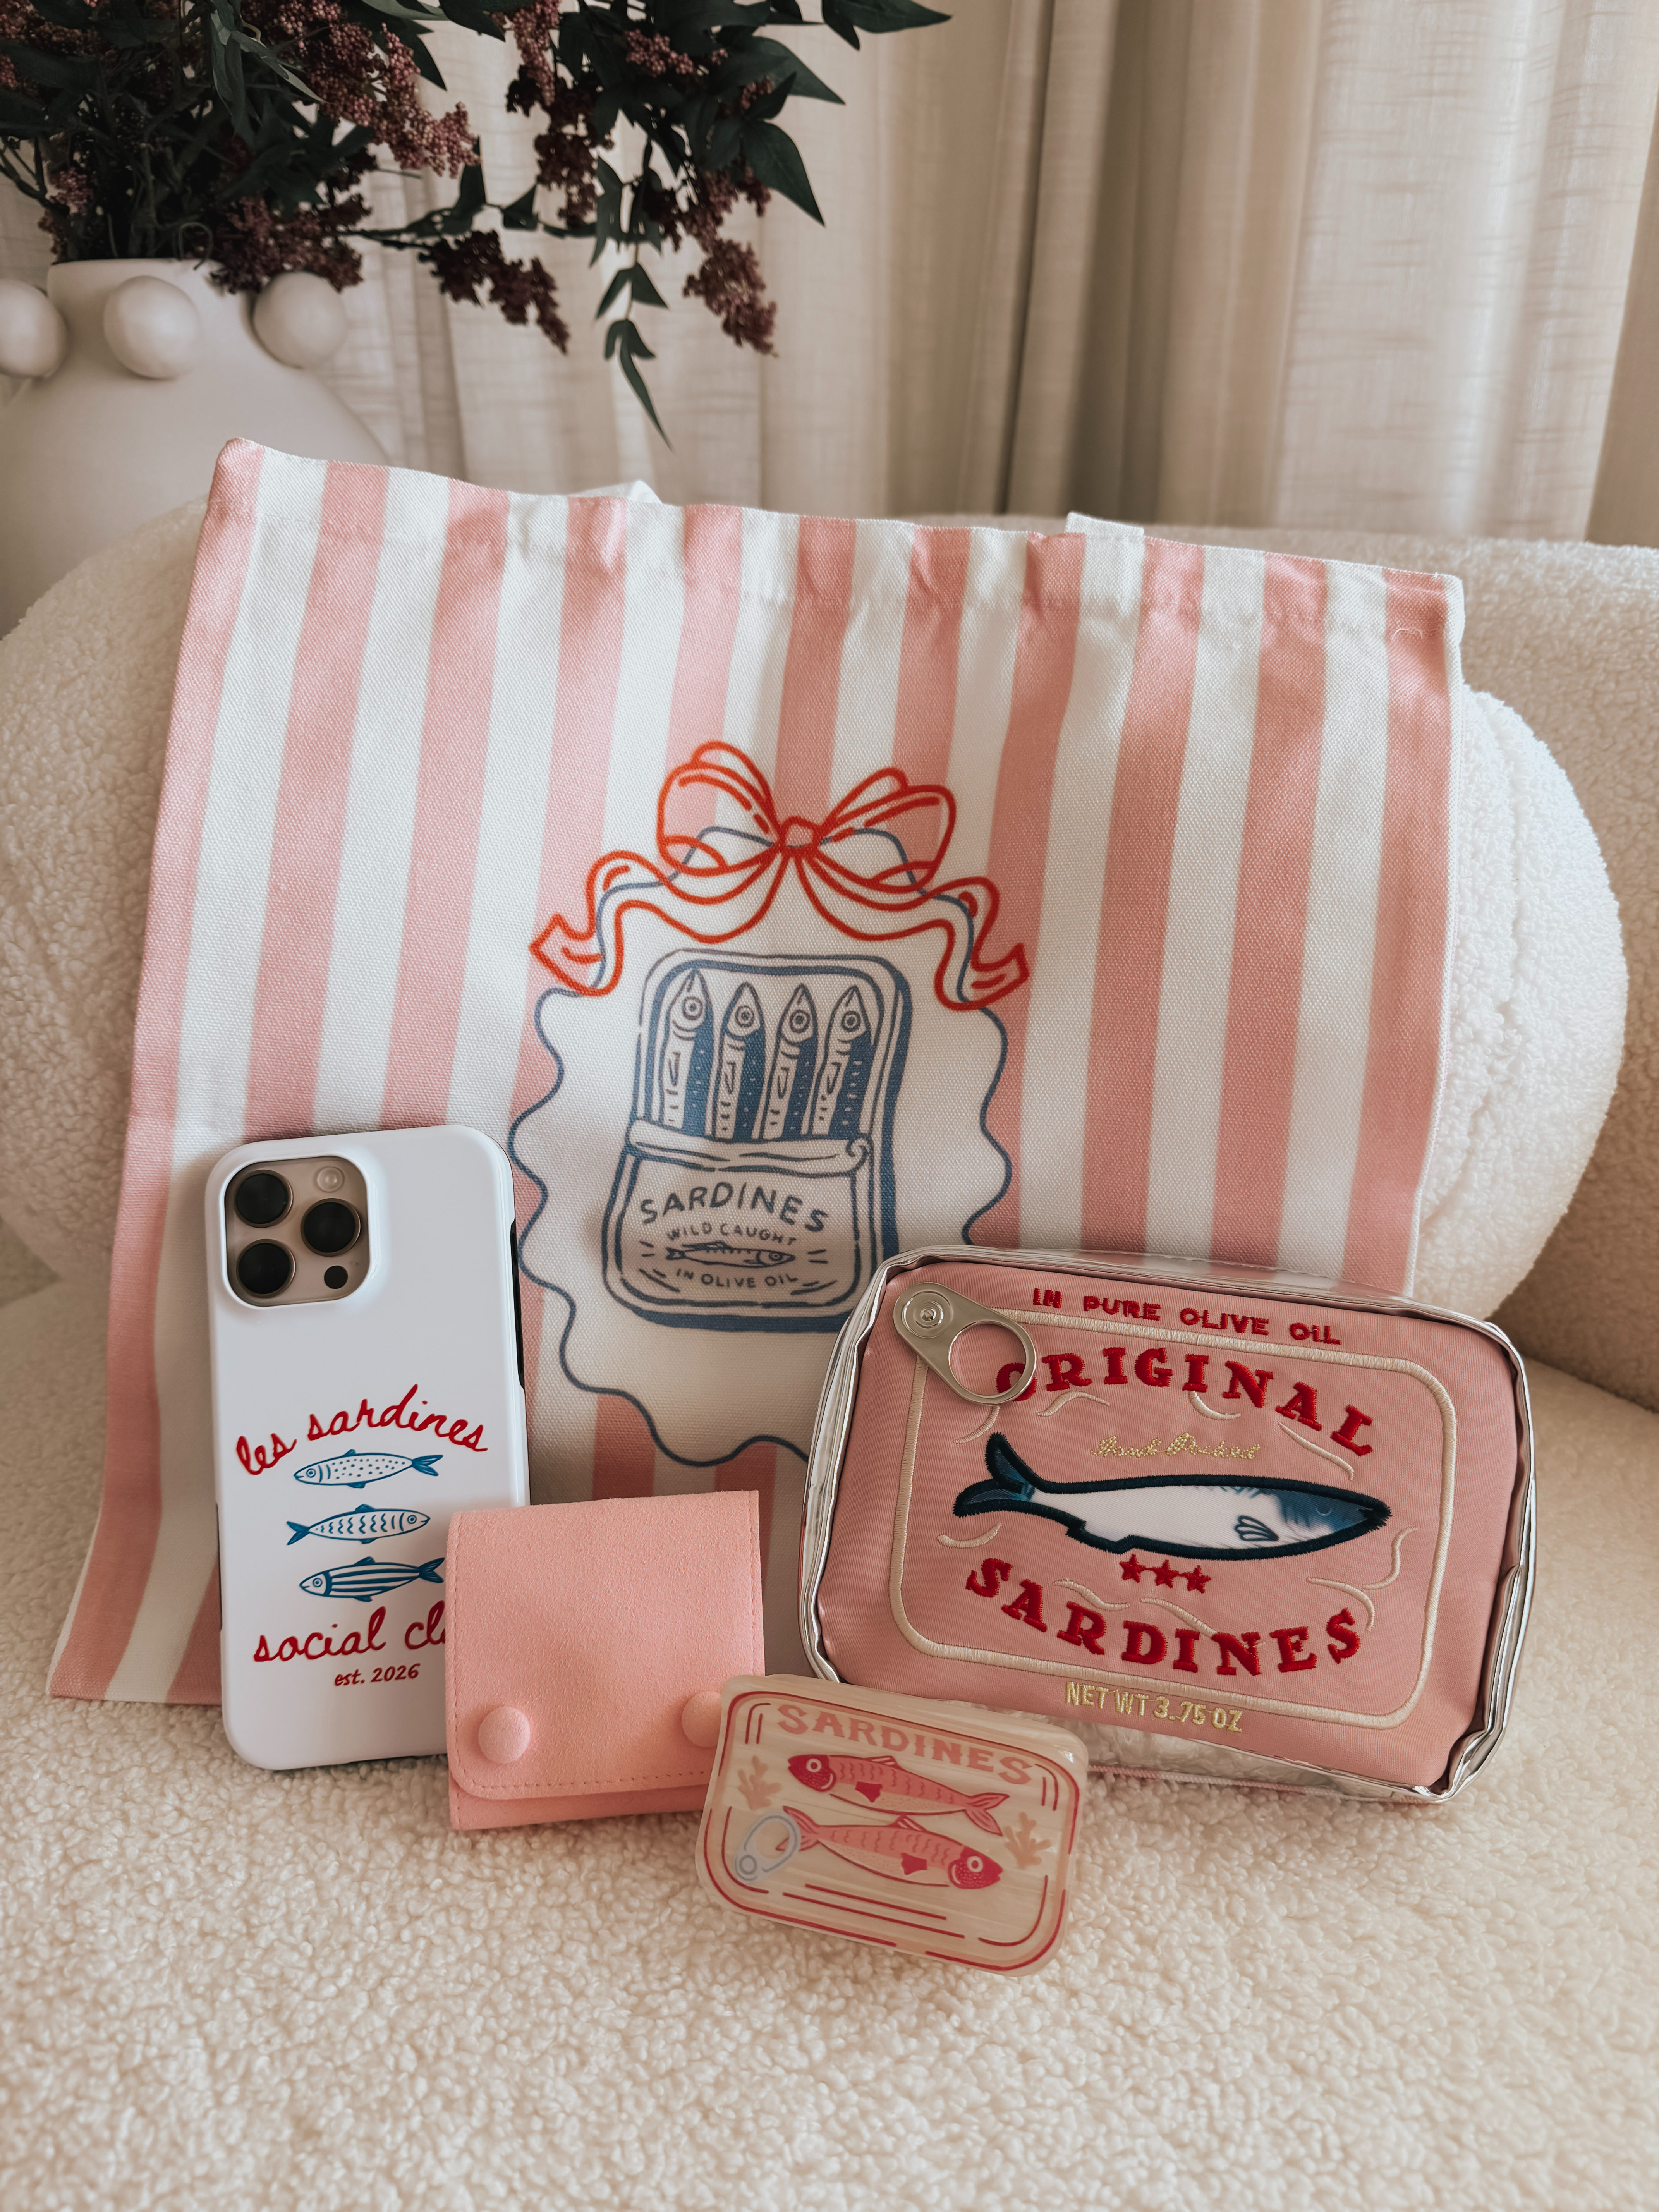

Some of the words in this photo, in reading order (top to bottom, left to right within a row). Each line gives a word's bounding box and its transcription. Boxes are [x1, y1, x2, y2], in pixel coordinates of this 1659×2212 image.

[640, 1182, 828, 1232] SARDINES
[666, 1223, 712, 1241] WILD
[720, 1224, 797, 1245] CAUGHT
[676, 1268, 695, 1279] IN
[701, 1273, 756, 1288] OLIVE
[764, 1273, 798, 1286] OIL
[1033, 1288, 1063, 1309] IN
[1083, 1295, 1161, 1321] PURE
[1180, 1308, 1269, 1336] OLIVE
[1288, 1322, 1341, 1345] OIL
[236, 1434, 297, 1475] les
[307, 1384, 488, 1452] sardines
[996, 1347, 1373, 1456] ORIGINAL
[253, 1606, 386, 1662] social
[405, 1599, 445, 1650] cl
[965, 1557, 1360, 1676] SARDINES
[334, 1669, 366, 1686] est.
[371, 1663, 421, 1683] 2026
[1066, 1682, 1109, 1709] NET
[1115, 1689, 1149, 1716] WT
[1153, 1696, 1206, 1725] 3.75
[1211, 1707, 1242, 1733] OZ
[776, 1704, 1033, 1785] SARDINES
